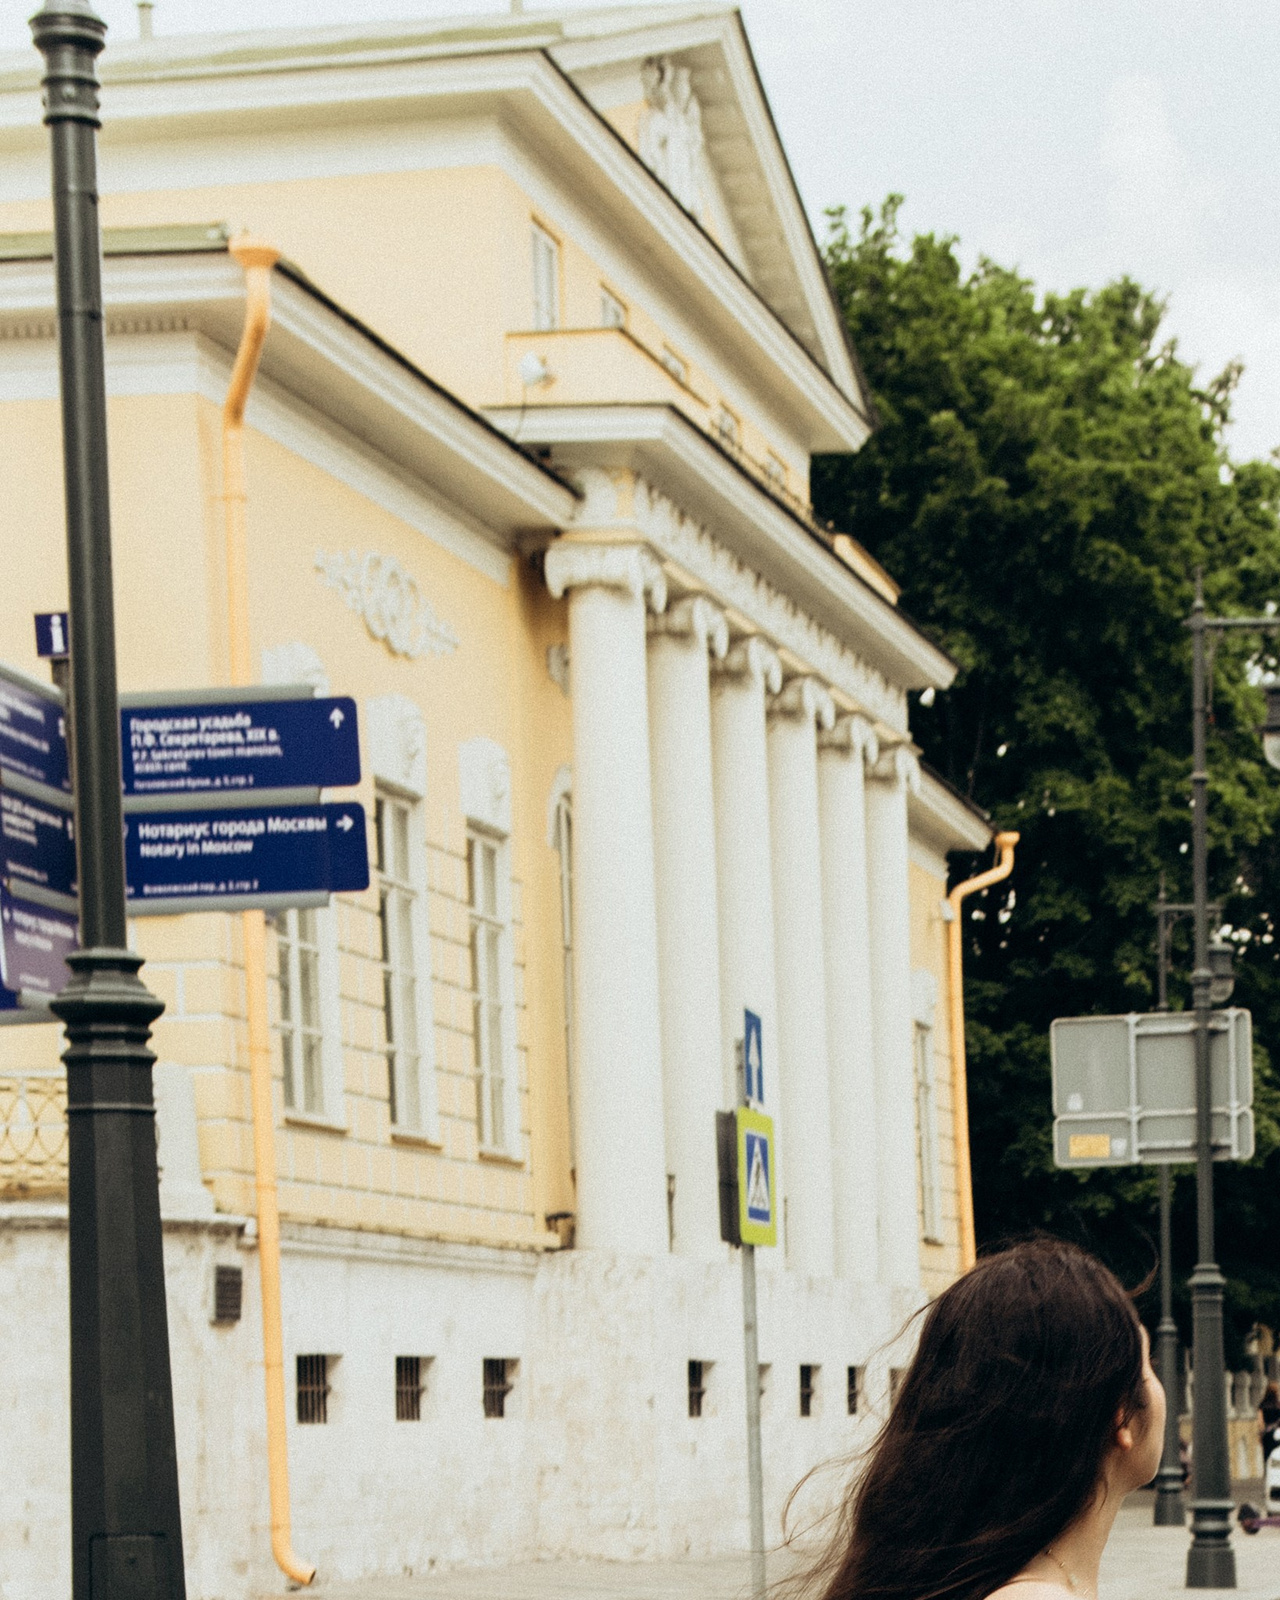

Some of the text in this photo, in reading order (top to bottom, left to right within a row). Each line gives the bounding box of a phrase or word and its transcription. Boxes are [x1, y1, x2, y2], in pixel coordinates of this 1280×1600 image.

[138, 817, 327, 841] Нотариус города Москвы
[140, 839, 254, 860] Notary in Moscow
